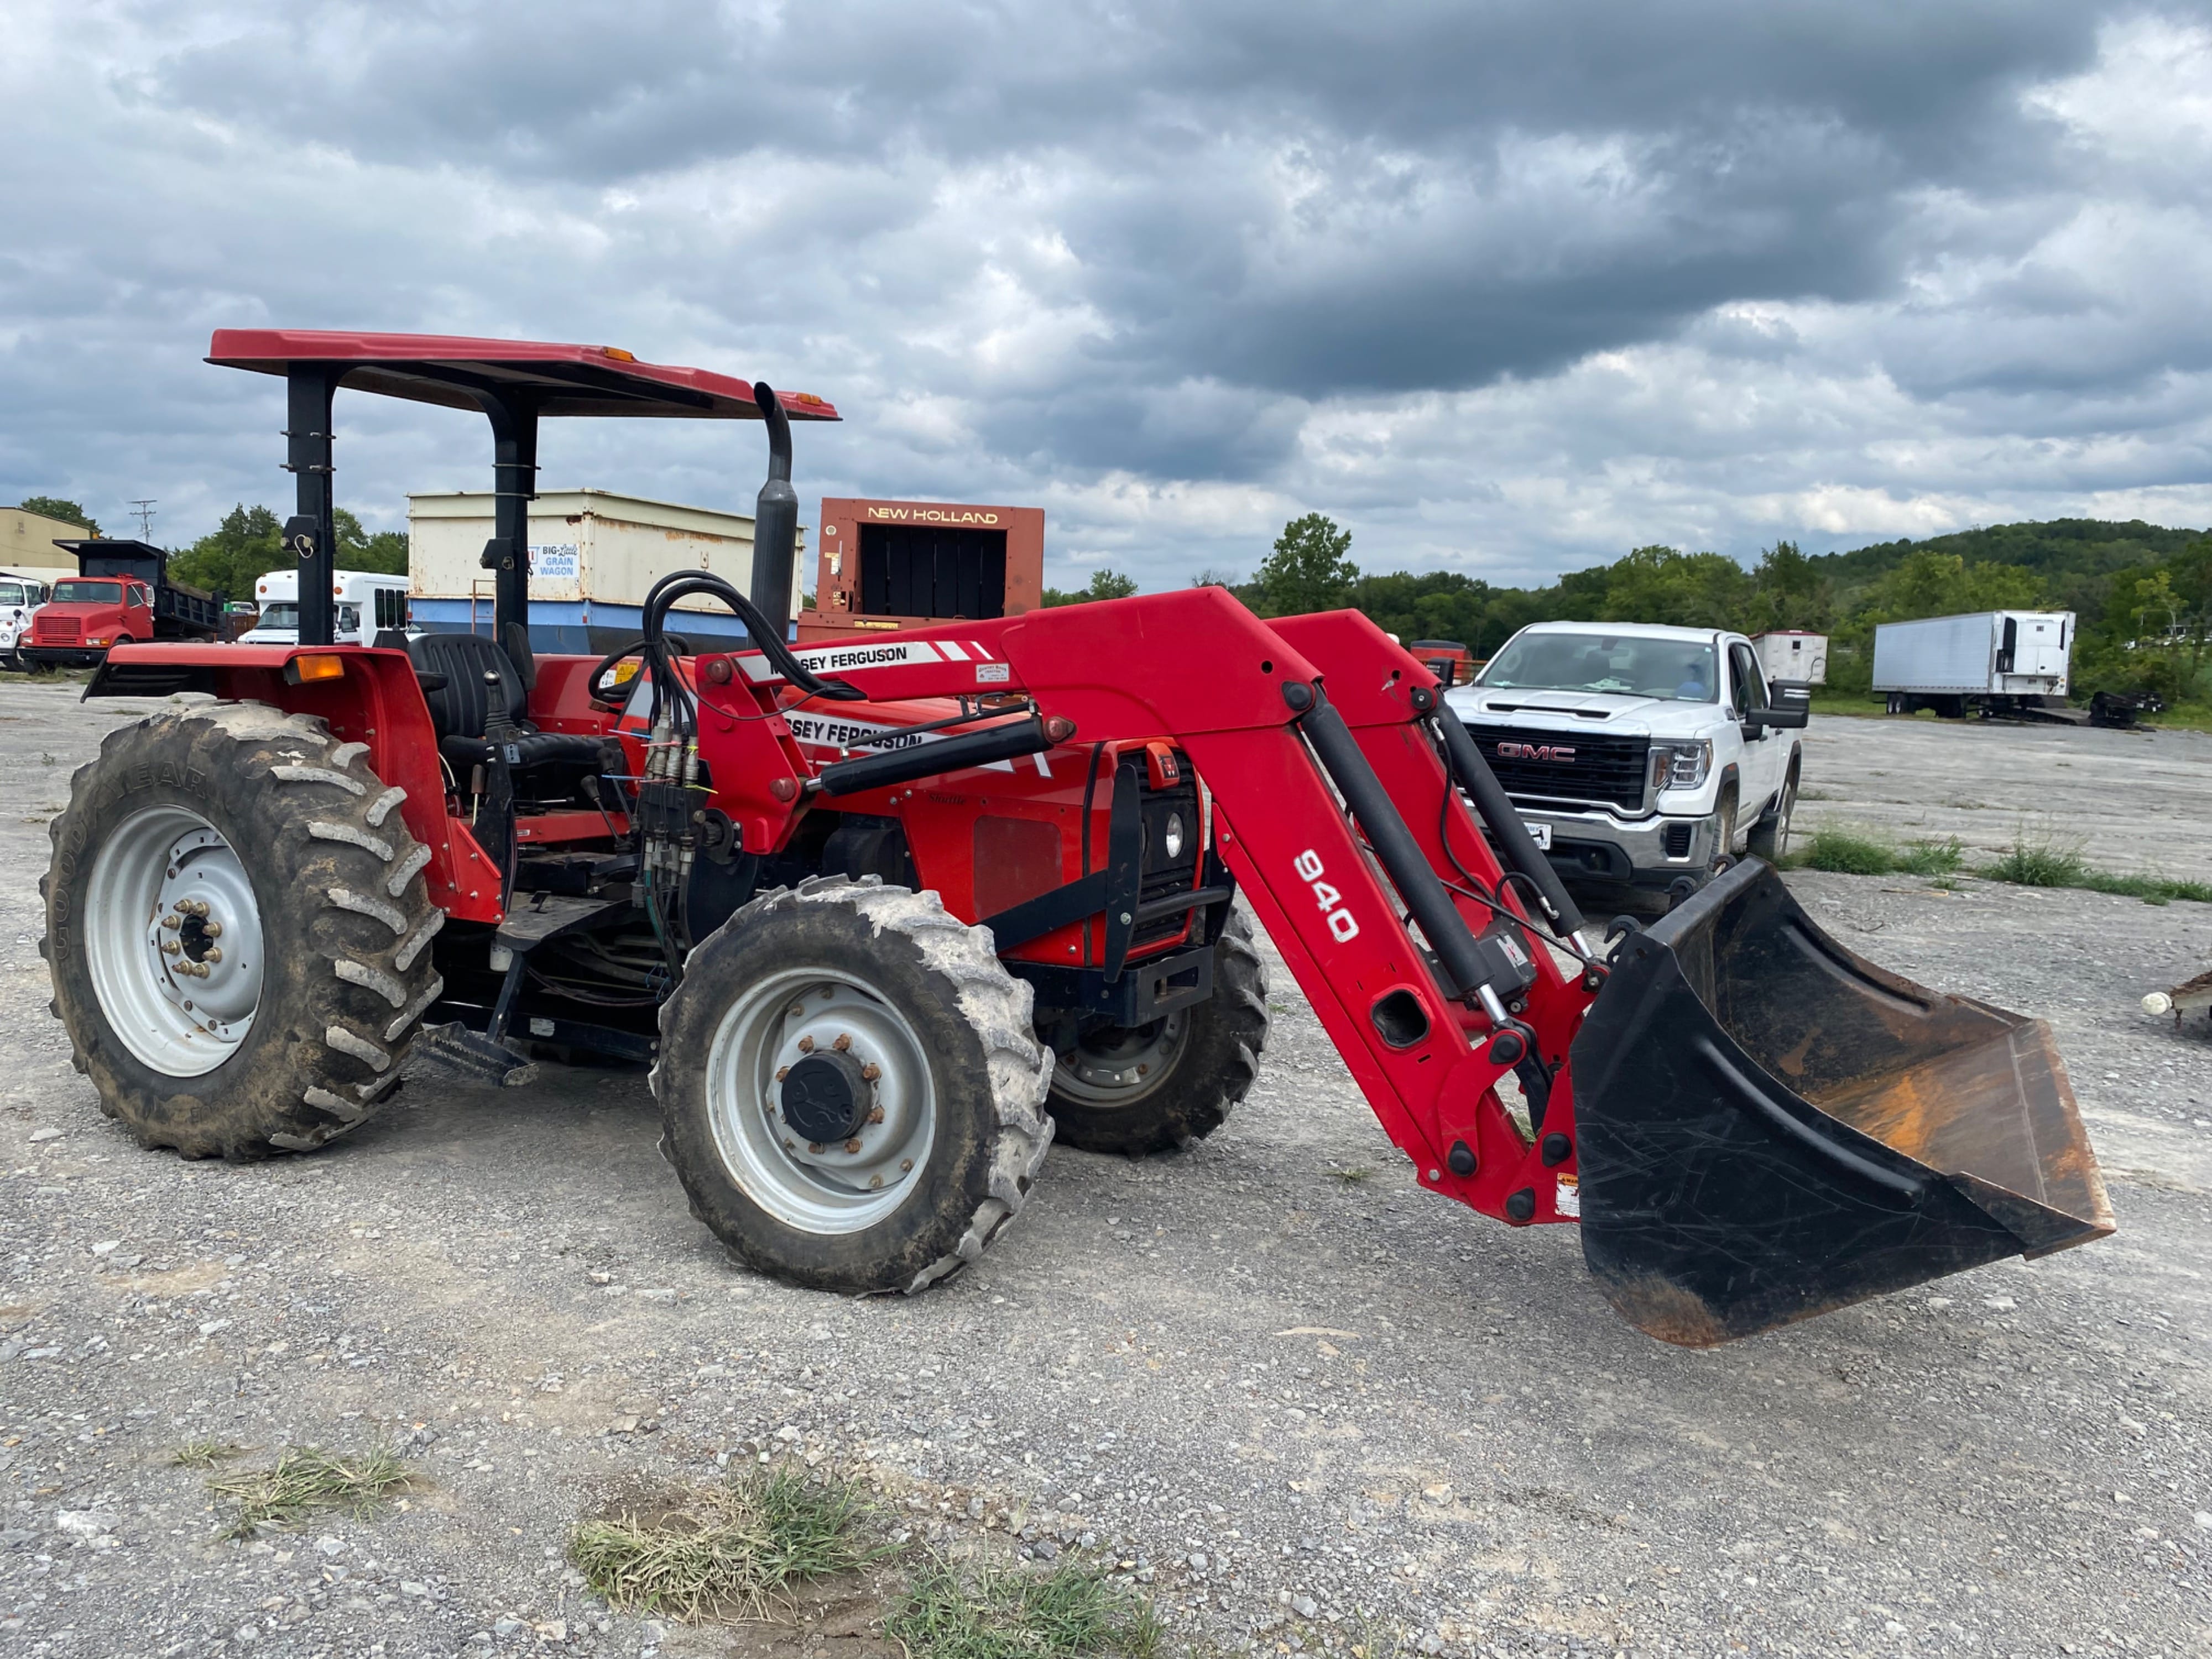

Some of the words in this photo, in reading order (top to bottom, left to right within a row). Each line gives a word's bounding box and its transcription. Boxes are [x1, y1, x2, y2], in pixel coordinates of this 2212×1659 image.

[868, 507, 909, 519] NEW
[914, 509, 998, 524] HOLLAND
[540, 567, 573, 576] WAGON
[546, 557, 573, 566] GRAIN
[831, 646, 907, 668] FERGUSON
[784, 718, 825, 740] SSEY
[1498, 742, 1575, 763] GMC
[1293, 849, 1360, 943] 940
